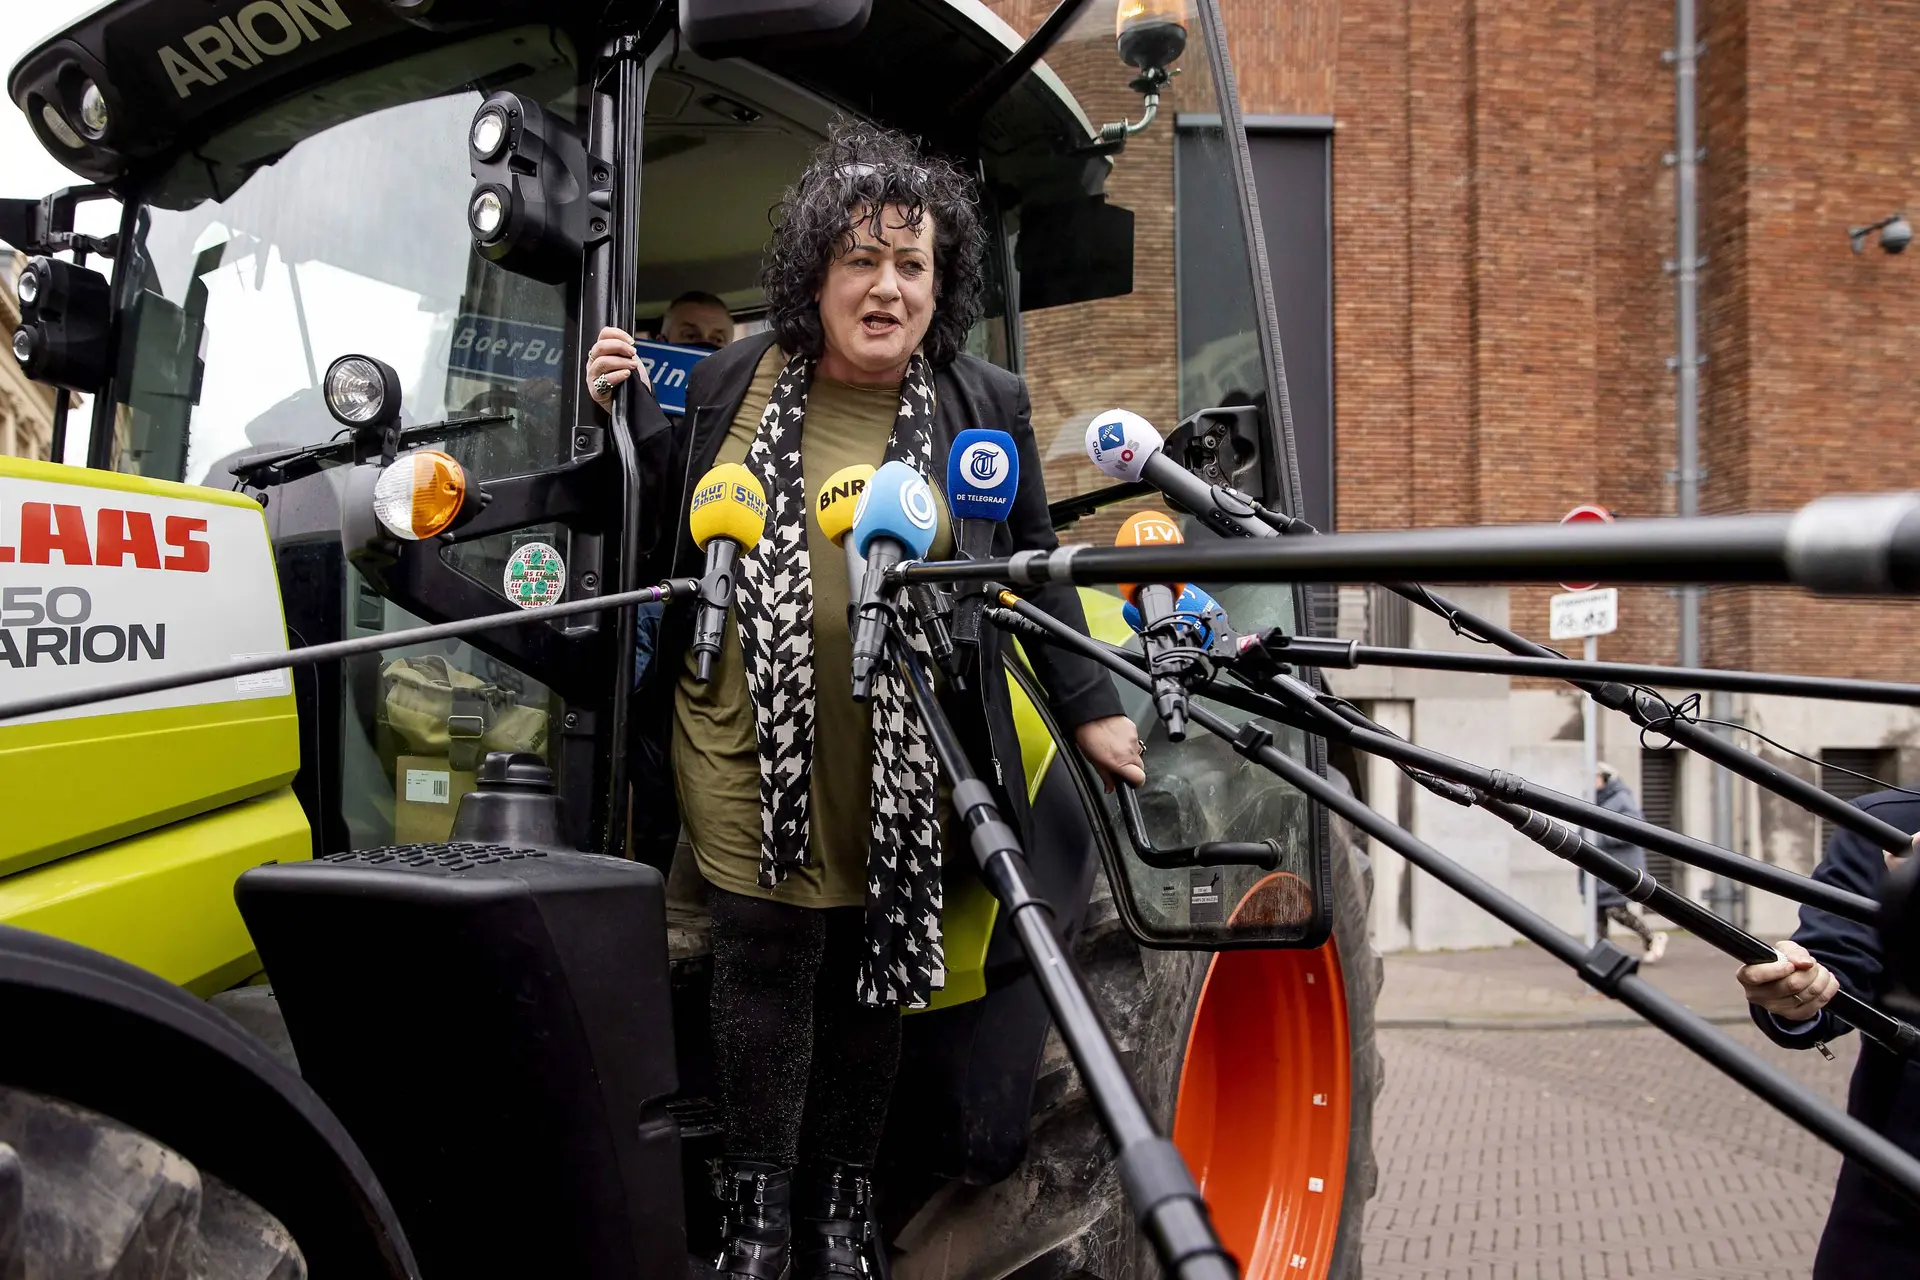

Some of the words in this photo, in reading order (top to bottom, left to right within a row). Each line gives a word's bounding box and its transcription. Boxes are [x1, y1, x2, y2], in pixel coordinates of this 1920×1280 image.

[157, 0, 352, 98] ARION
[1100, 424, 1114, 442] radio
[1115, 439, 1140, 472] NOS
[700, 493, 722, 505] show
[820, 479, 867, 511] BNR
[967, 494, 1007, 504] TELEGRAAF
[0, 586, 92, 627] 50
